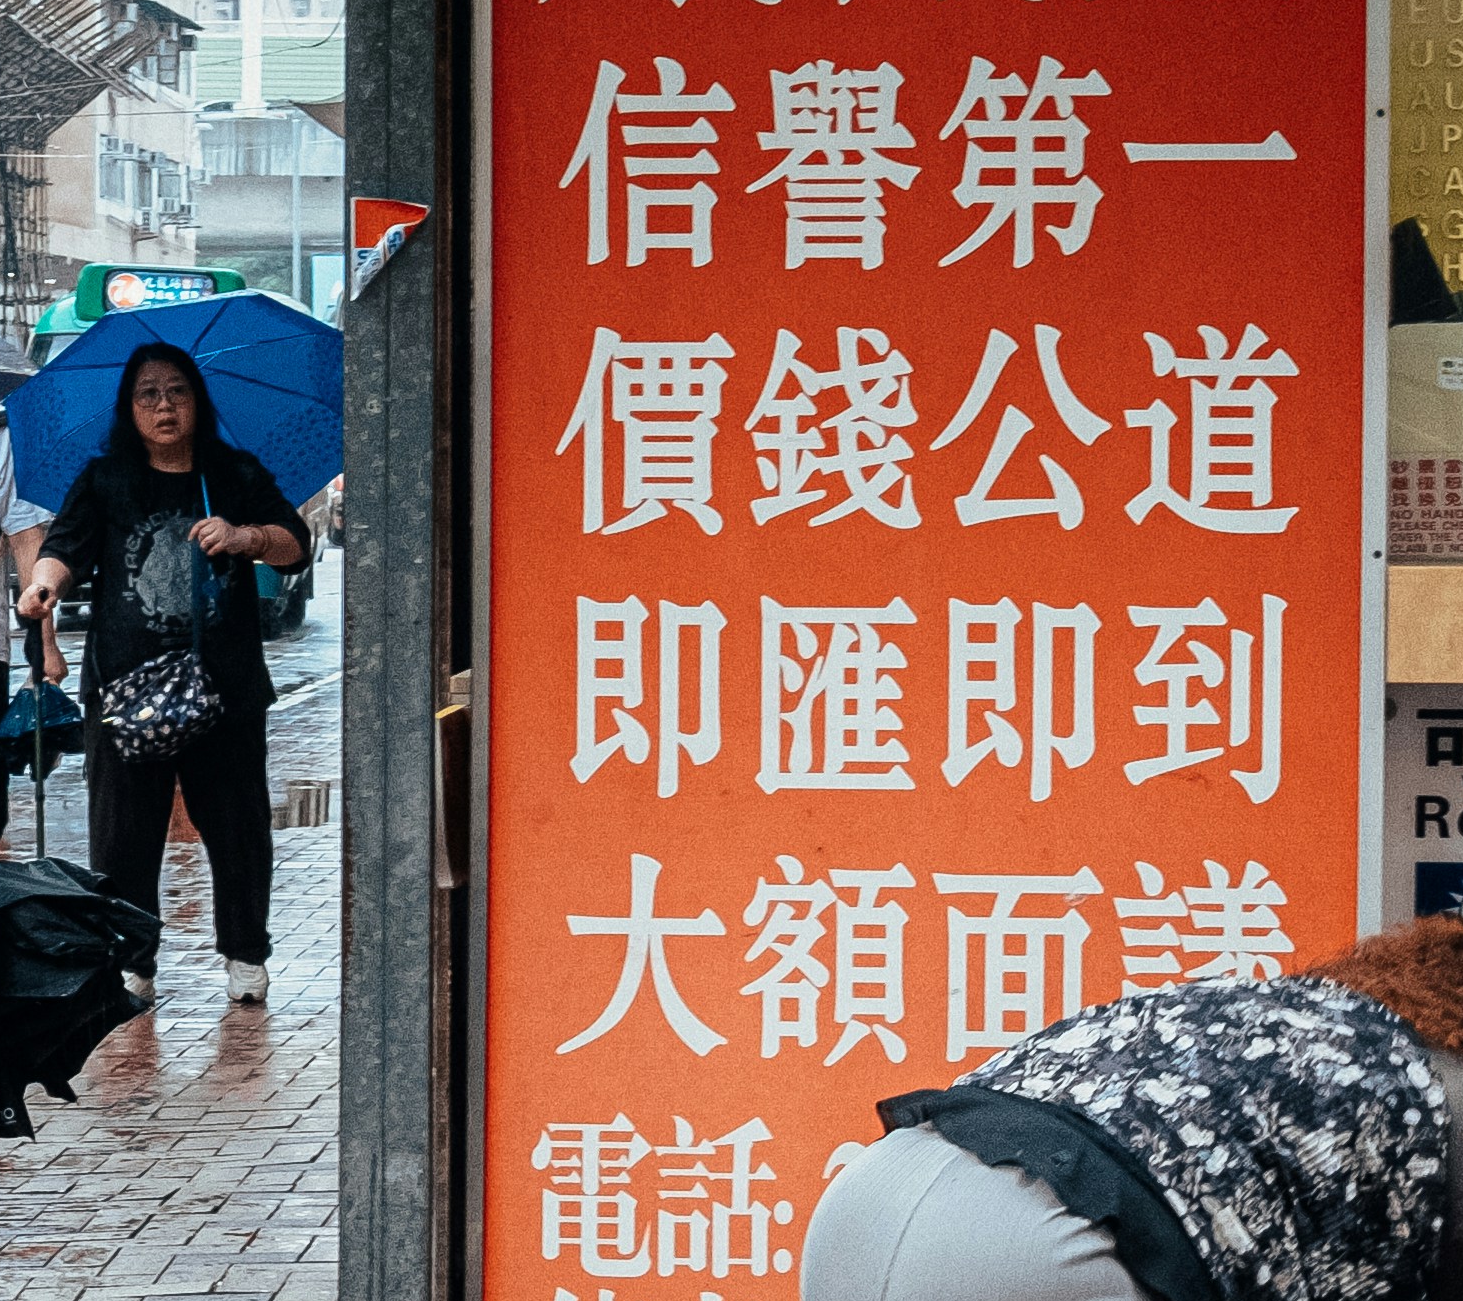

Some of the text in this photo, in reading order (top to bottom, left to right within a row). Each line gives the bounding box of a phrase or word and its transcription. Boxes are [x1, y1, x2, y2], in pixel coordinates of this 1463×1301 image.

[559, 55, 1299, 268] 信譽第一
[555, 323, 1300, 536] 價錢公道
[570, 593, 1289, 805] 即匯即到
[555, 852, 1295, 1067] 大額面議
